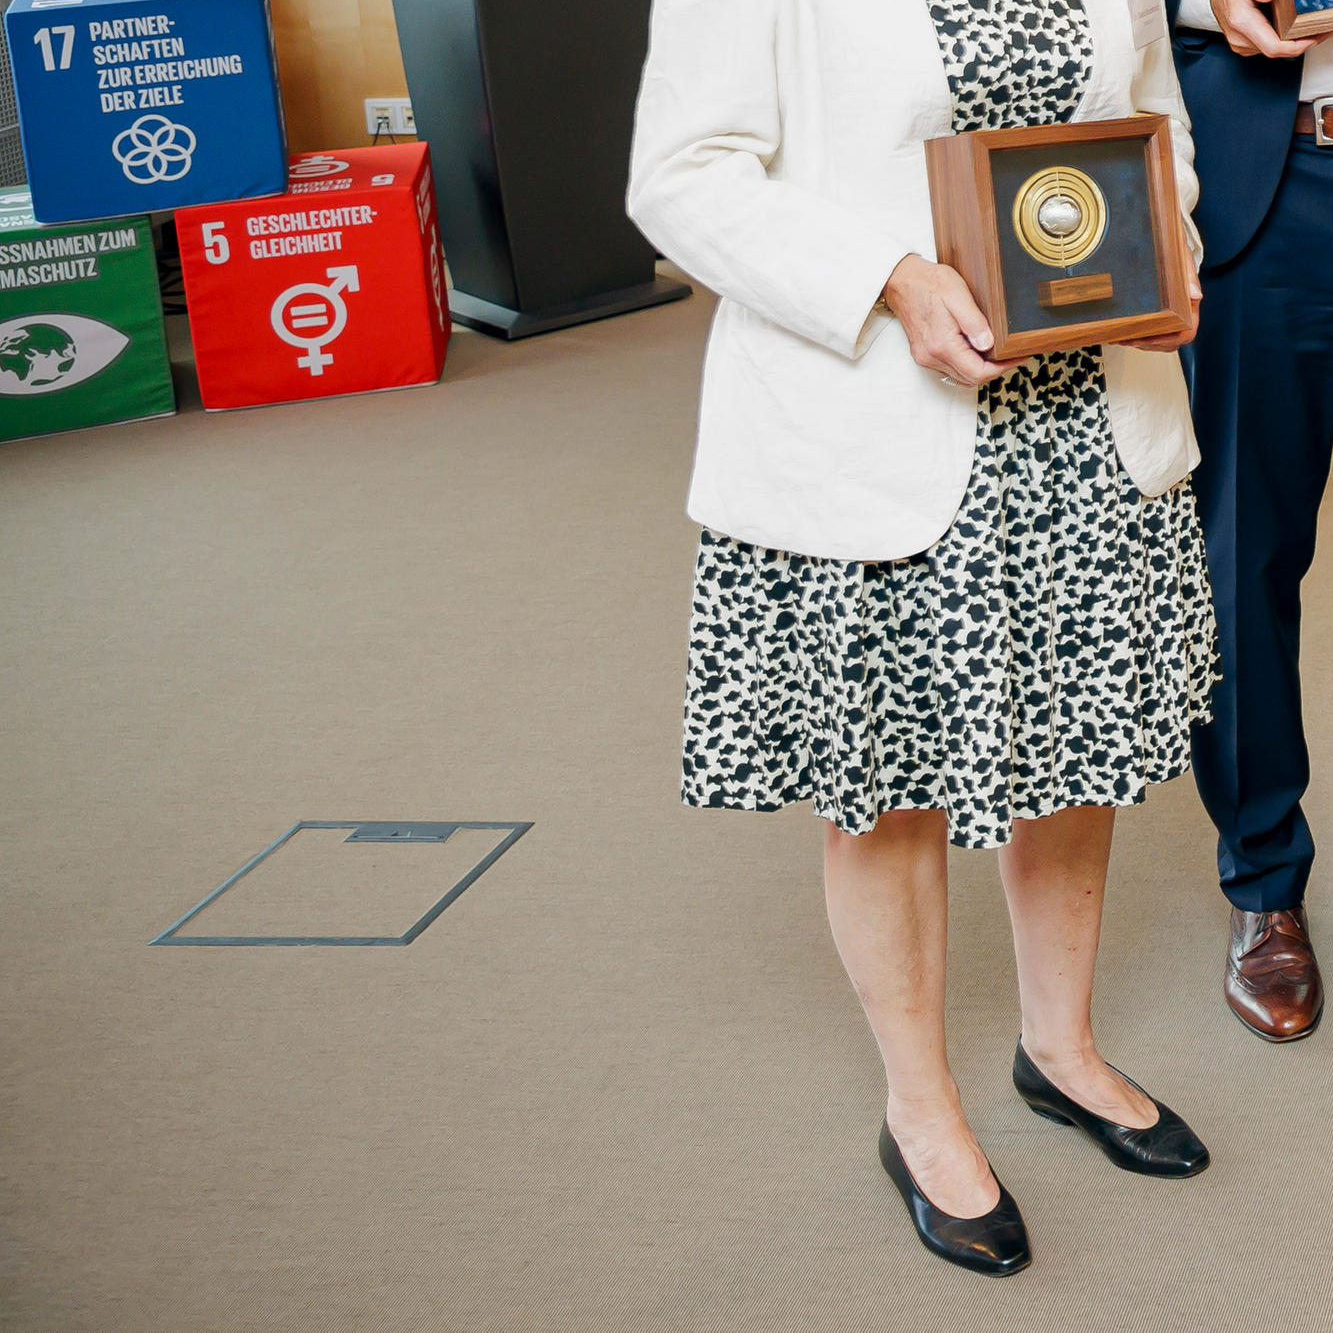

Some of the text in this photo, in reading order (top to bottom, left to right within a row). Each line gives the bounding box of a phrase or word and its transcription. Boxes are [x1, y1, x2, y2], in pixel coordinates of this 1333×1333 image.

[89, 15, 176, 42] PARTNER-
[33, 25, 75, 72] 17
[93, 37, 185, 65] SCHAFTEN
[97, 54, 243, 89] ZUR ERREICHUNG
[101, 85, 184, 113] DER ZIELE
[247, 205, 378, 237] GESCHLECHTER-
[98, 228, 136, 252] ZUM
[202, 221, 230, 265] 5
[250, 232, 342, 260] GLEICHHEIT
[0, 258, 98, 289] MASCHUTZ
